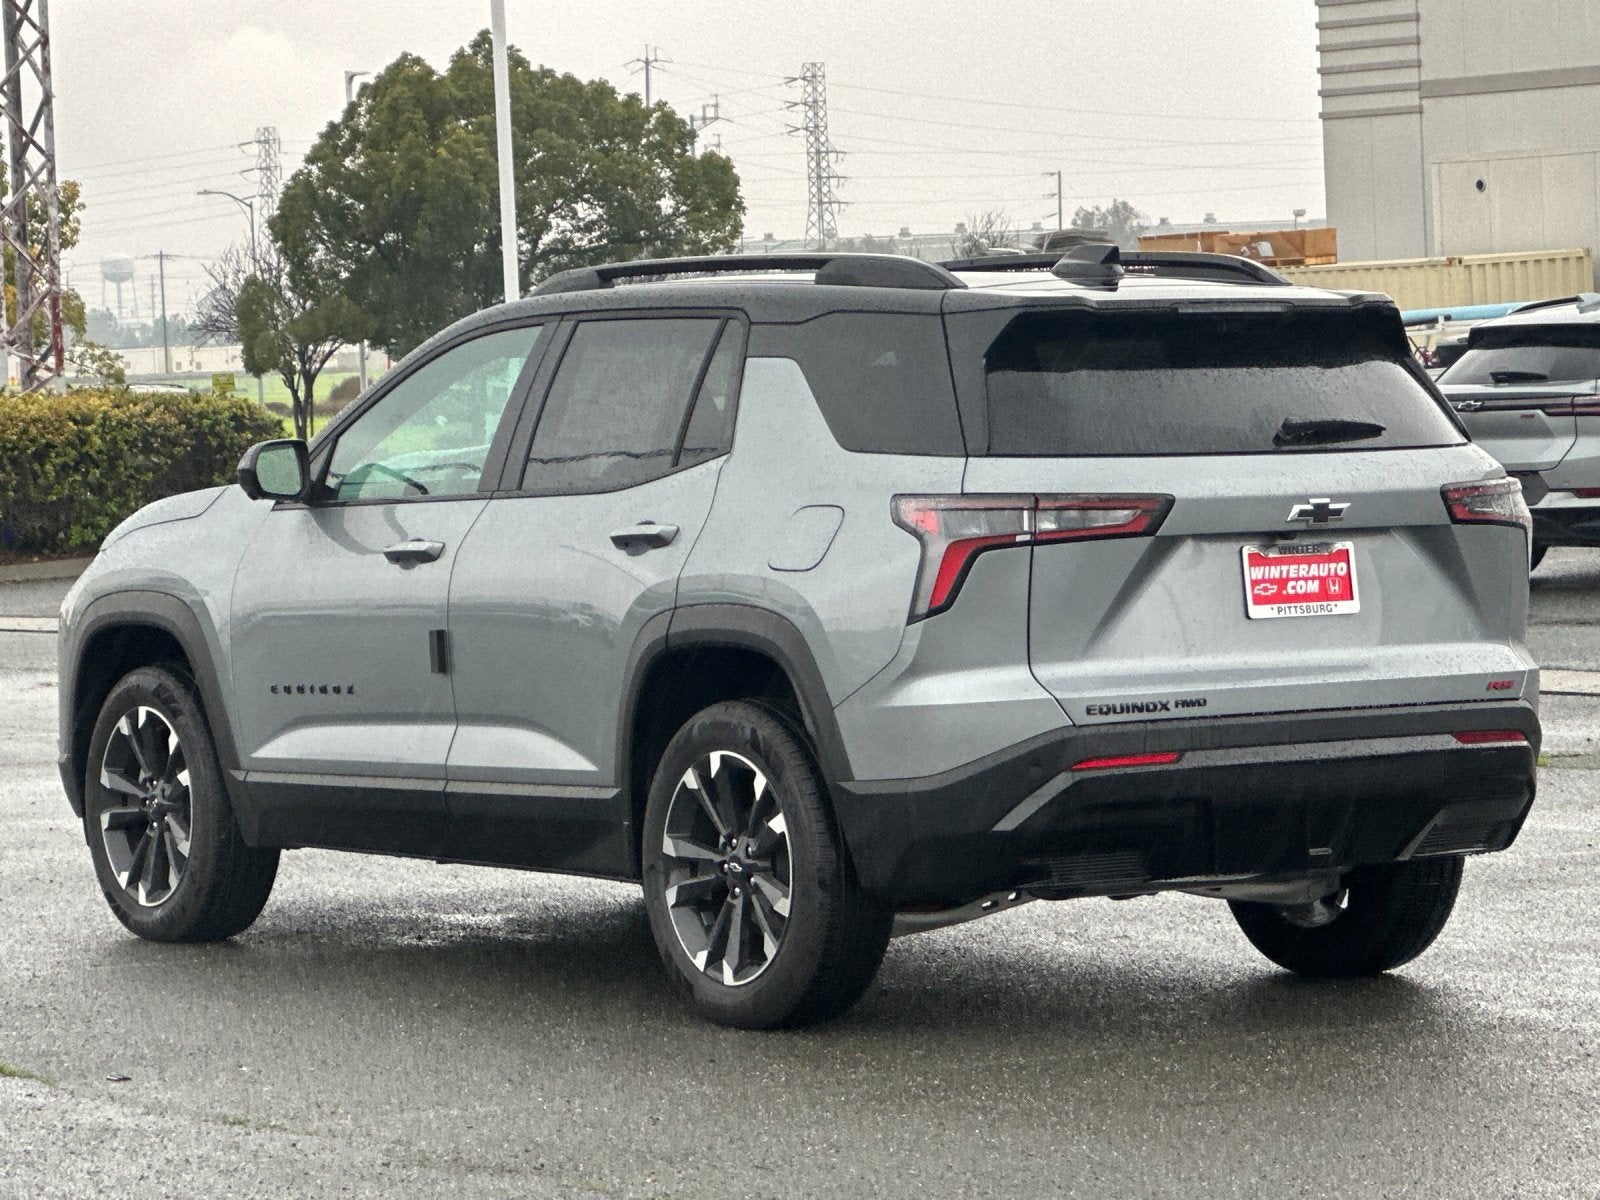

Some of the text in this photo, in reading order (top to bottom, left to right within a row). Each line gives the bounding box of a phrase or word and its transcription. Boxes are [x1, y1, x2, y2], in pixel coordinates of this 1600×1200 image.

[1279, 544, 1321, 554] WINTER
[1250, 562, 1347, 580] WINTERAUTO
[1282, 580, 1319, 595] .COM
[1277, 604, 1333, 615] PITTSBURG
[1086, 700, 1171, 716] EQUINOX
